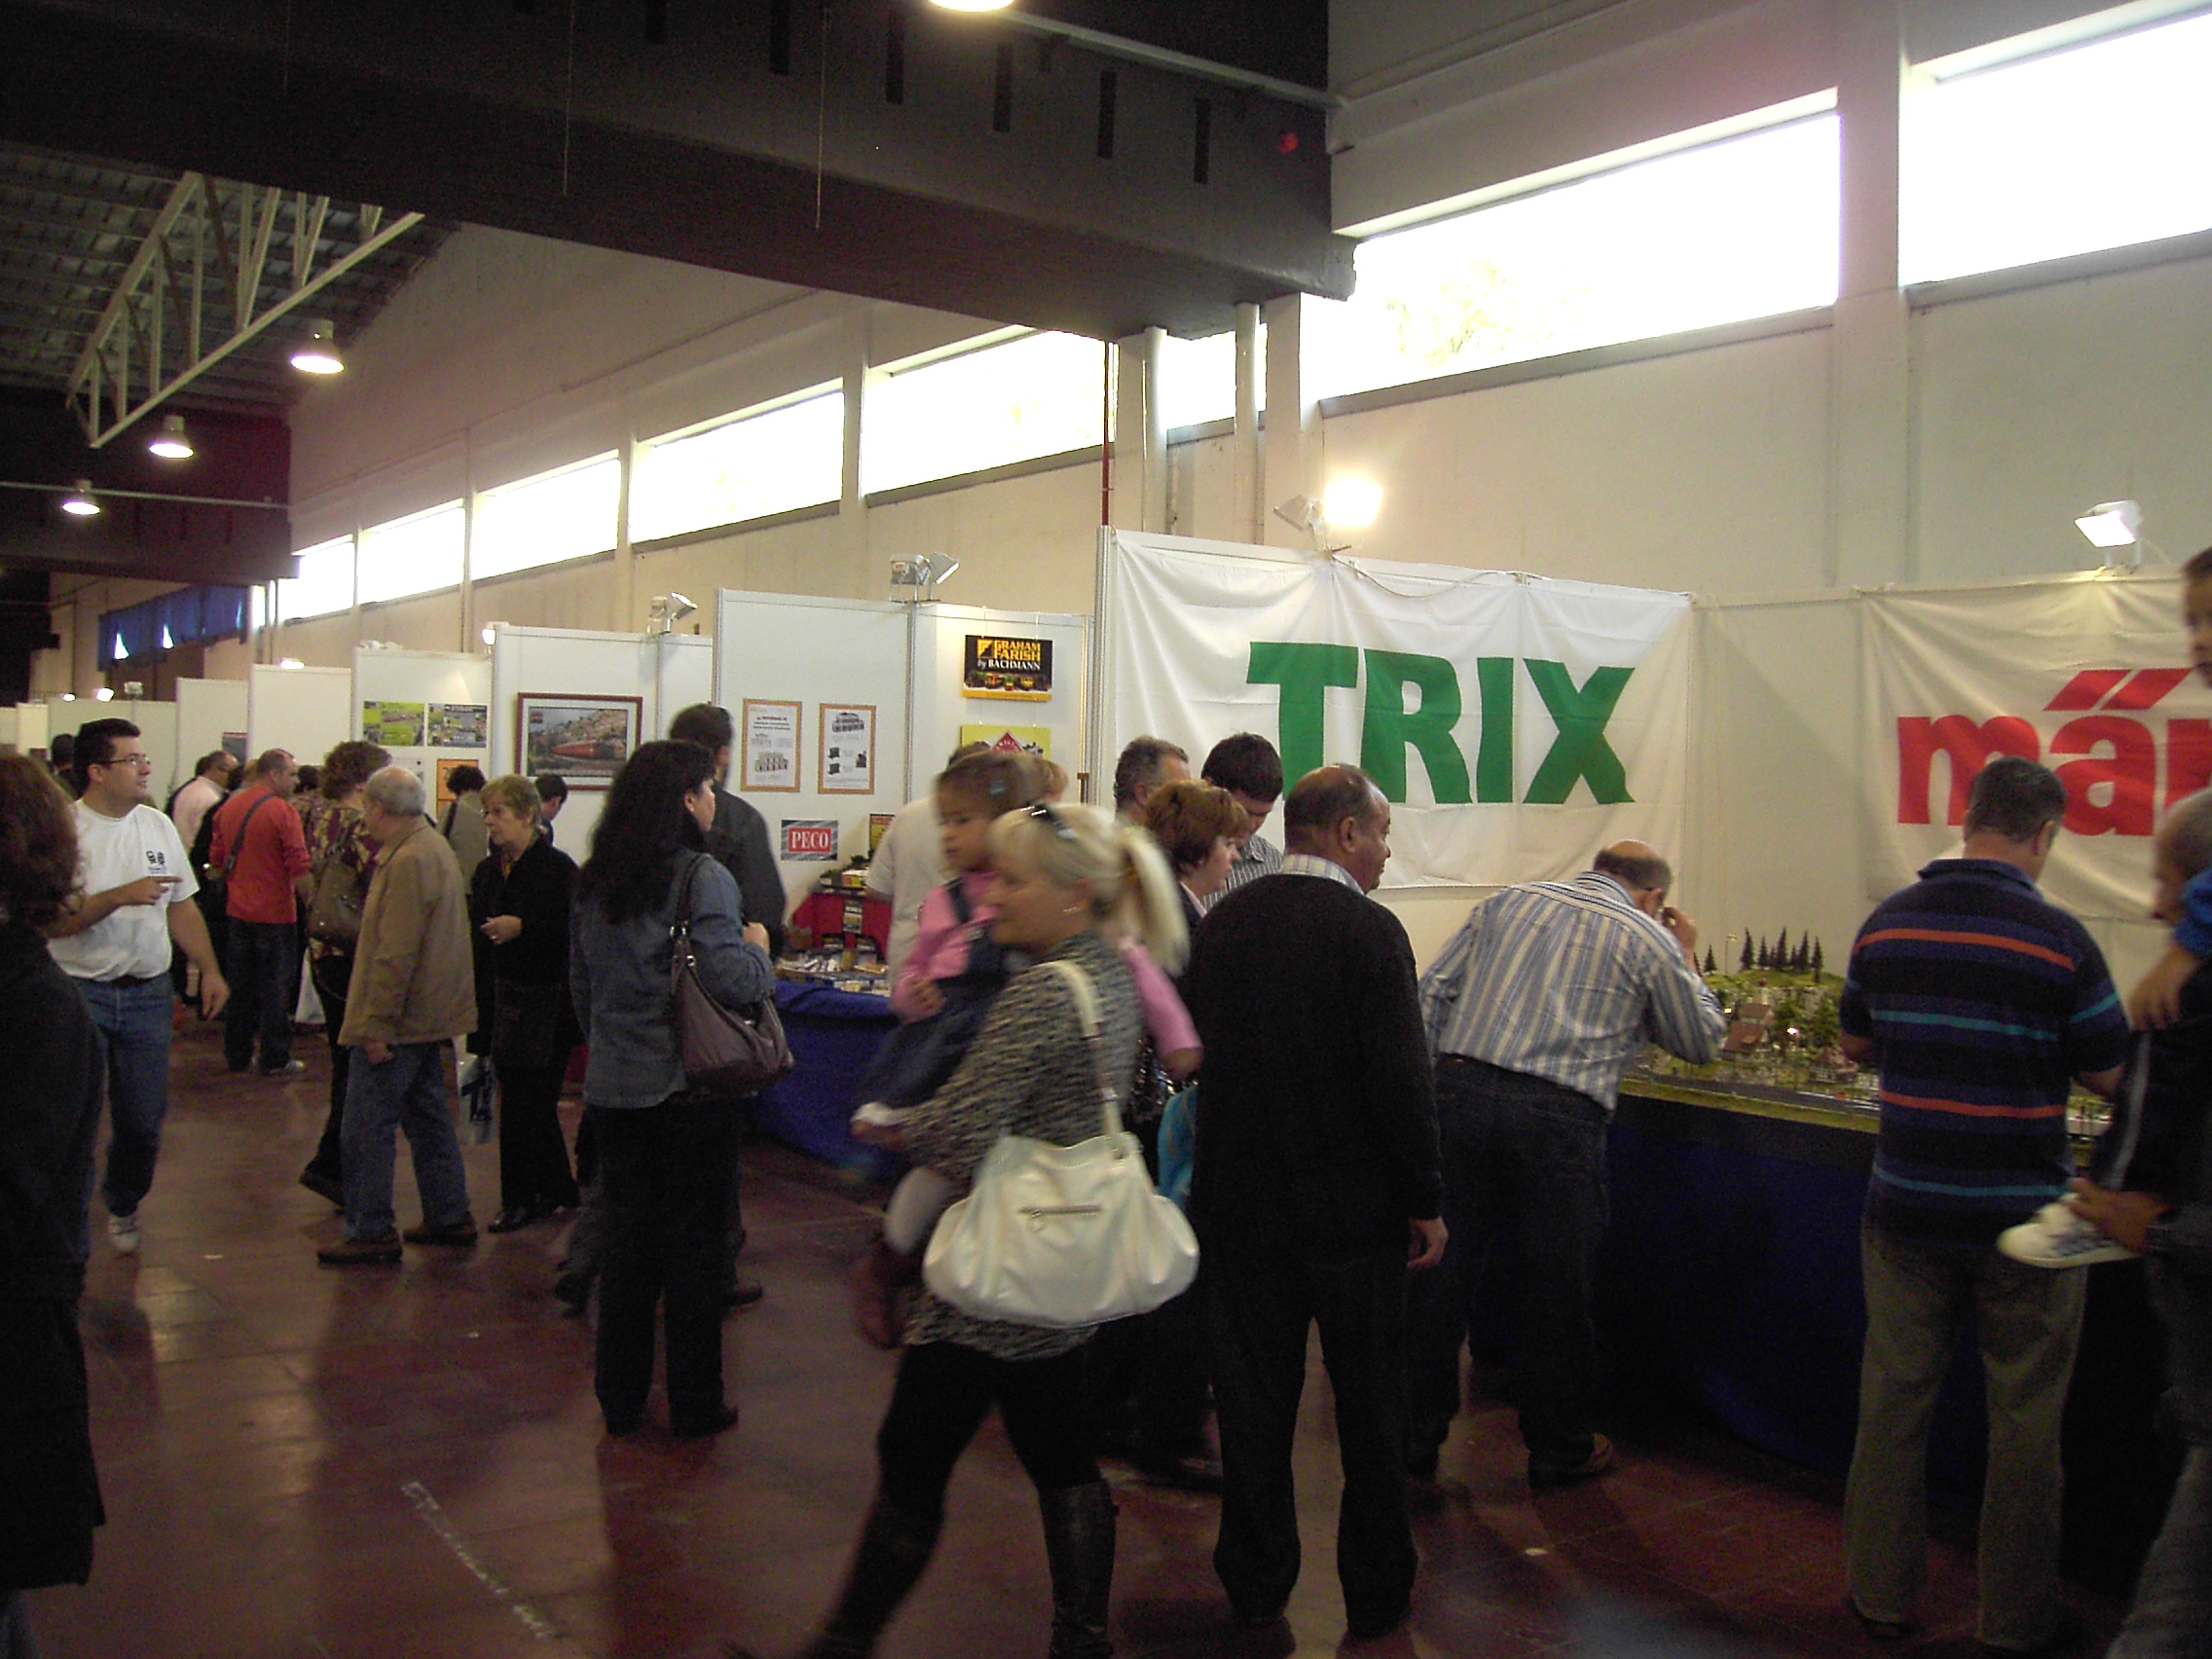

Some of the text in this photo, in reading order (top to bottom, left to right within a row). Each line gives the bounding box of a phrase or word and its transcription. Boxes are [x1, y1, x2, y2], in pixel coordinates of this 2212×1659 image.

[994, 640, 1041, 652] GRAHAM
[994, 649, 1041, 662] FARISH
[977, 659, 1041, 670] by BACHMANN
[1246, 642, 1636, 804] TRIX
[792, 831, 830, 849] PECO
